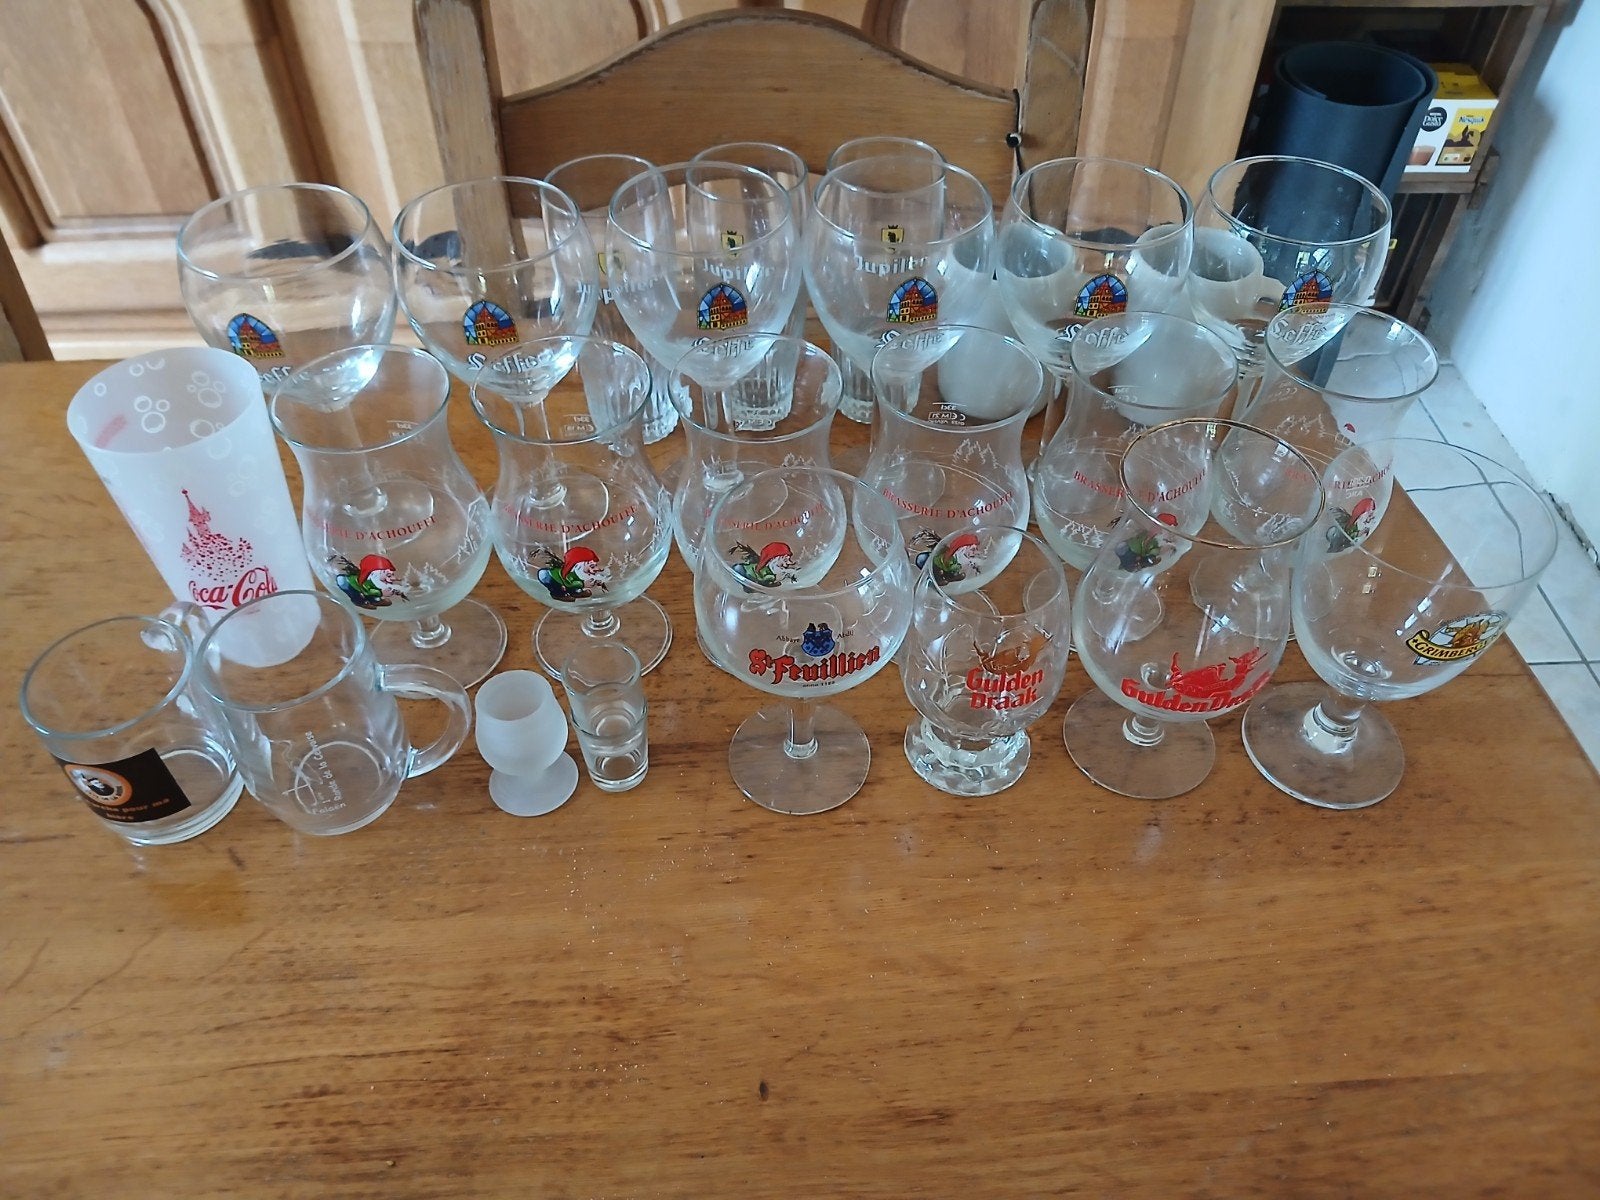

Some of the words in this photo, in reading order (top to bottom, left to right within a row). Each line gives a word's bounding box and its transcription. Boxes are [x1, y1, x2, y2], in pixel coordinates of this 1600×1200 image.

[703, 259, 775, 283] Jupilr
[1073, 470, 1128, 498] BRASSER
[771, 645, 881, 685] Feuillien
[966, 667, 1044, 692] Gulden
[970, 687, 1038, 711] Draak
[1121, 677, 1208, 713] Gulden
